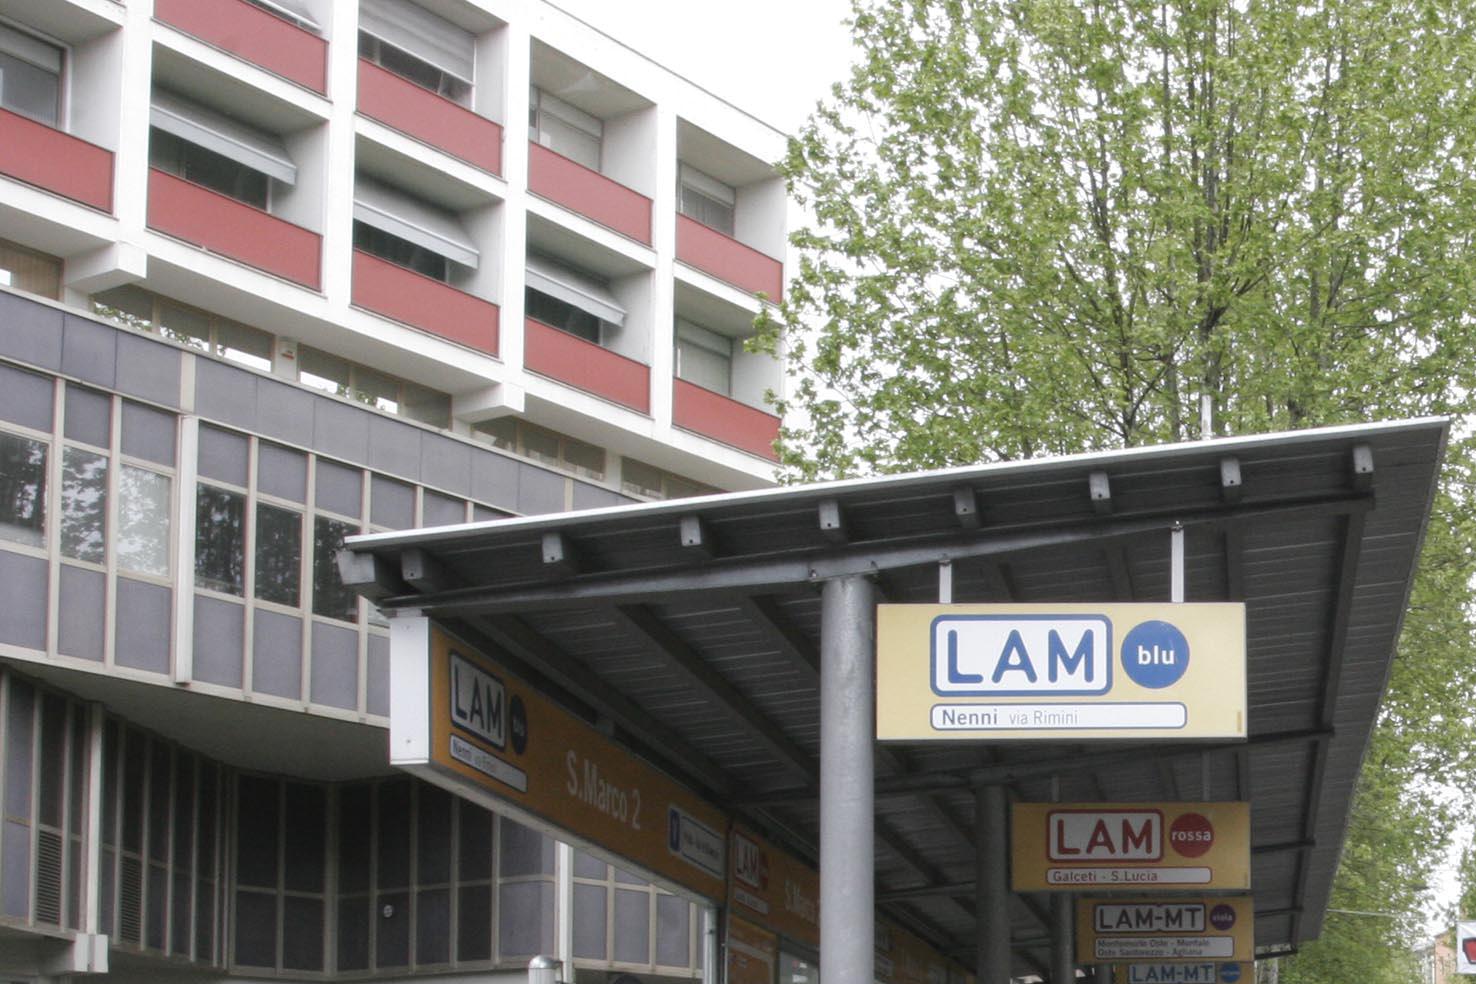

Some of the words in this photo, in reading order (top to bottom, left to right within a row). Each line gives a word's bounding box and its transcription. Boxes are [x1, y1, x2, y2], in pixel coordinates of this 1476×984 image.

[947, 629, 1094, 684] LAM
[1137, 645, 1175, 665] blu
[454, 664, 503, 739] LAM
[942, 708, 998, 726] Nenni
[1009, 709, 1031, 726] via
[1033, 709, 1078, 726] Rimini
[566, 750, 628, 821] S.Marco
[632, 789, 641, 830] 2
[1057, 819, 1153, 855] LAM
[1171, 831, 1212, 841] rossa
[1053, 871, 1097, 882] Galceti
[1111, 871, 1159, 882] S.Lucia
[1100, 908, 1203, 930] LAM-MT
[1131, 965, 1213, 982] LAM-MT
